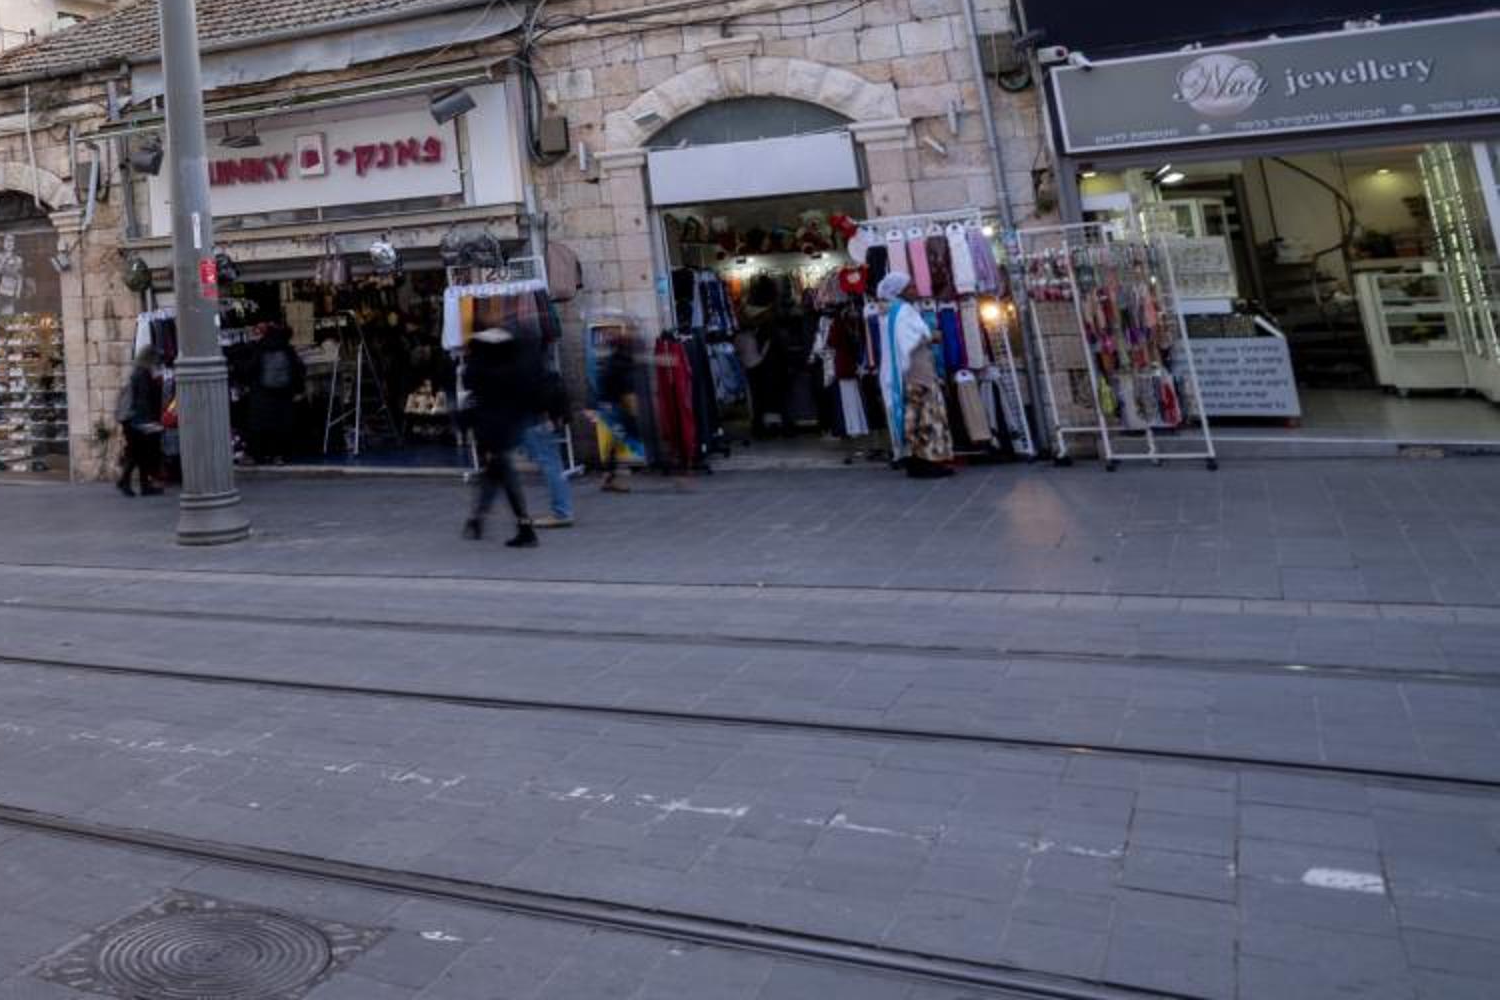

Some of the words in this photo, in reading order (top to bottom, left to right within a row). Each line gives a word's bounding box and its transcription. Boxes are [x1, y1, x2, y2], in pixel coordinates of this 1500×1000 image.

[1285, 57, 1434, 96] jewellery
[208, 153, 293, 187] UNKY
[334, 136, 443, 177] פאנקי
